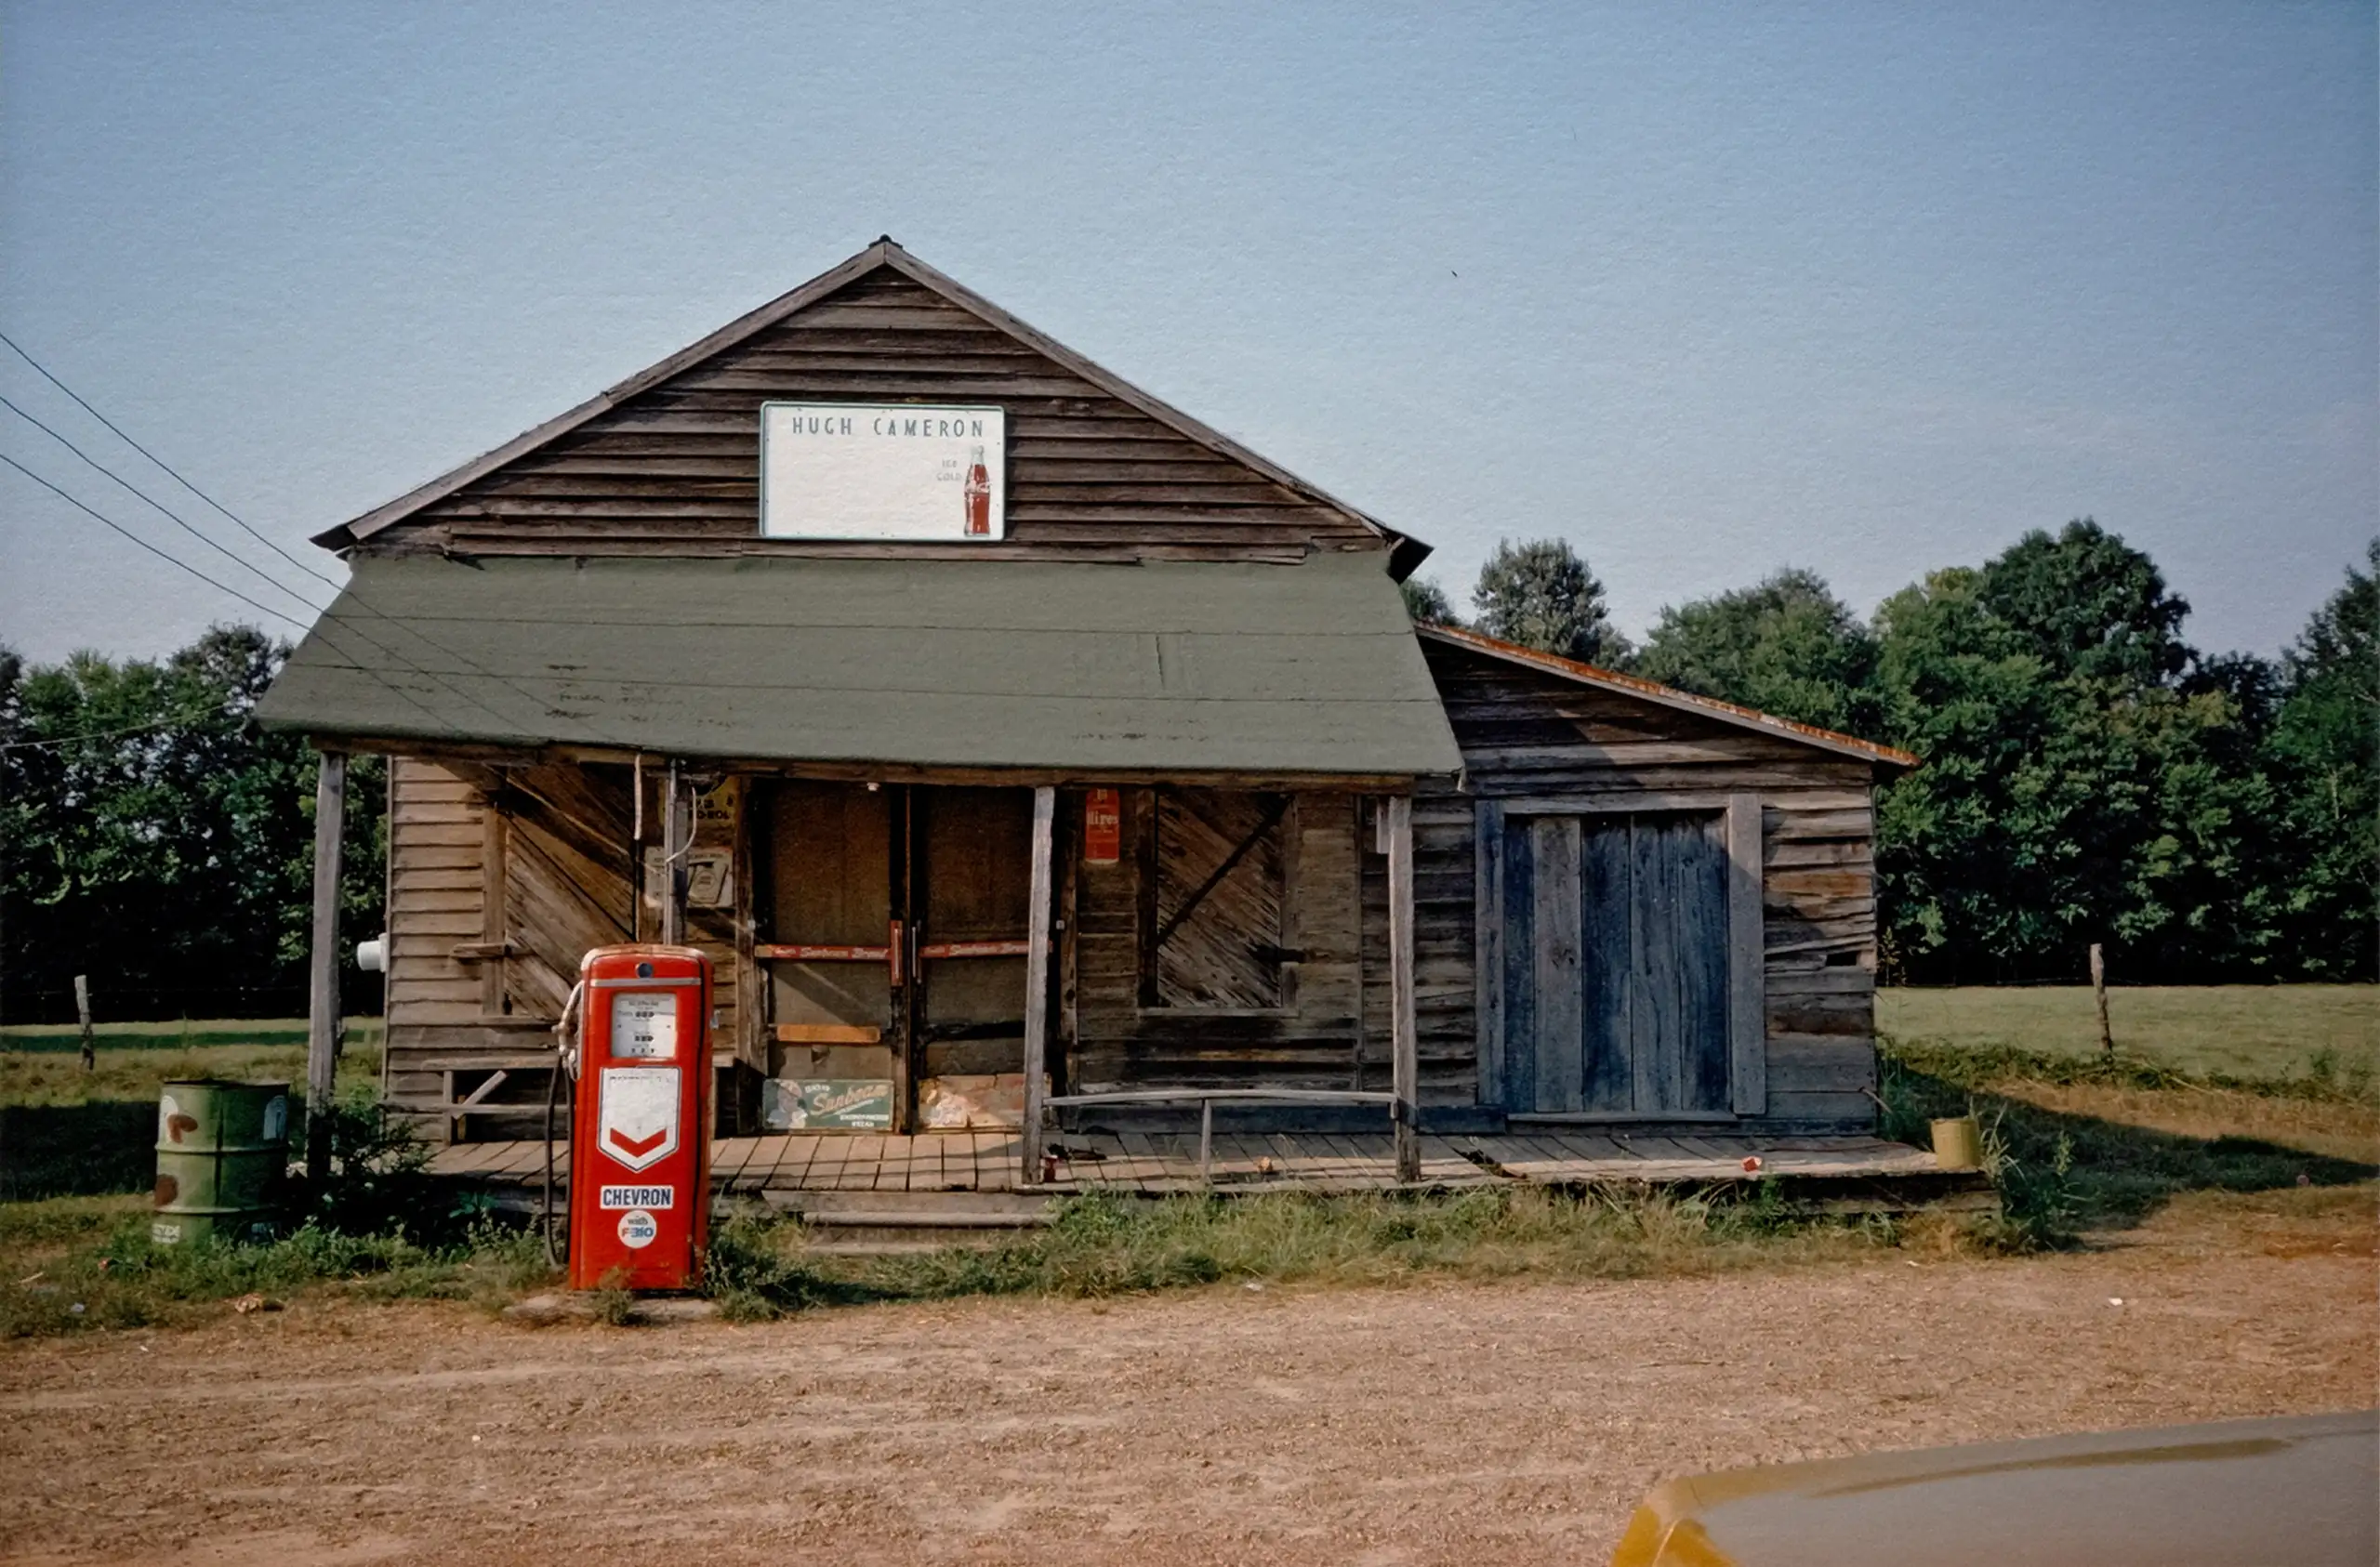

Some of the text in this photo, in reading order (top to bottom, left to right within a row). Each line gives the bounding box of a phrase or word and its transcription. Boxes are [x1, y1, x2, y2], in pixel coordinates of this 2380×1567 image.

[792, 417, 984, 437] HUGH CAMERON
[942, 459, 957, 467] ICE
[937, 473, 962, 481] COLD
[810, 1084, 889, 1115] Sunbeam
[602, 1189, 671, 1205] CHEVRON
[627, 1216, 649, 1225] with
